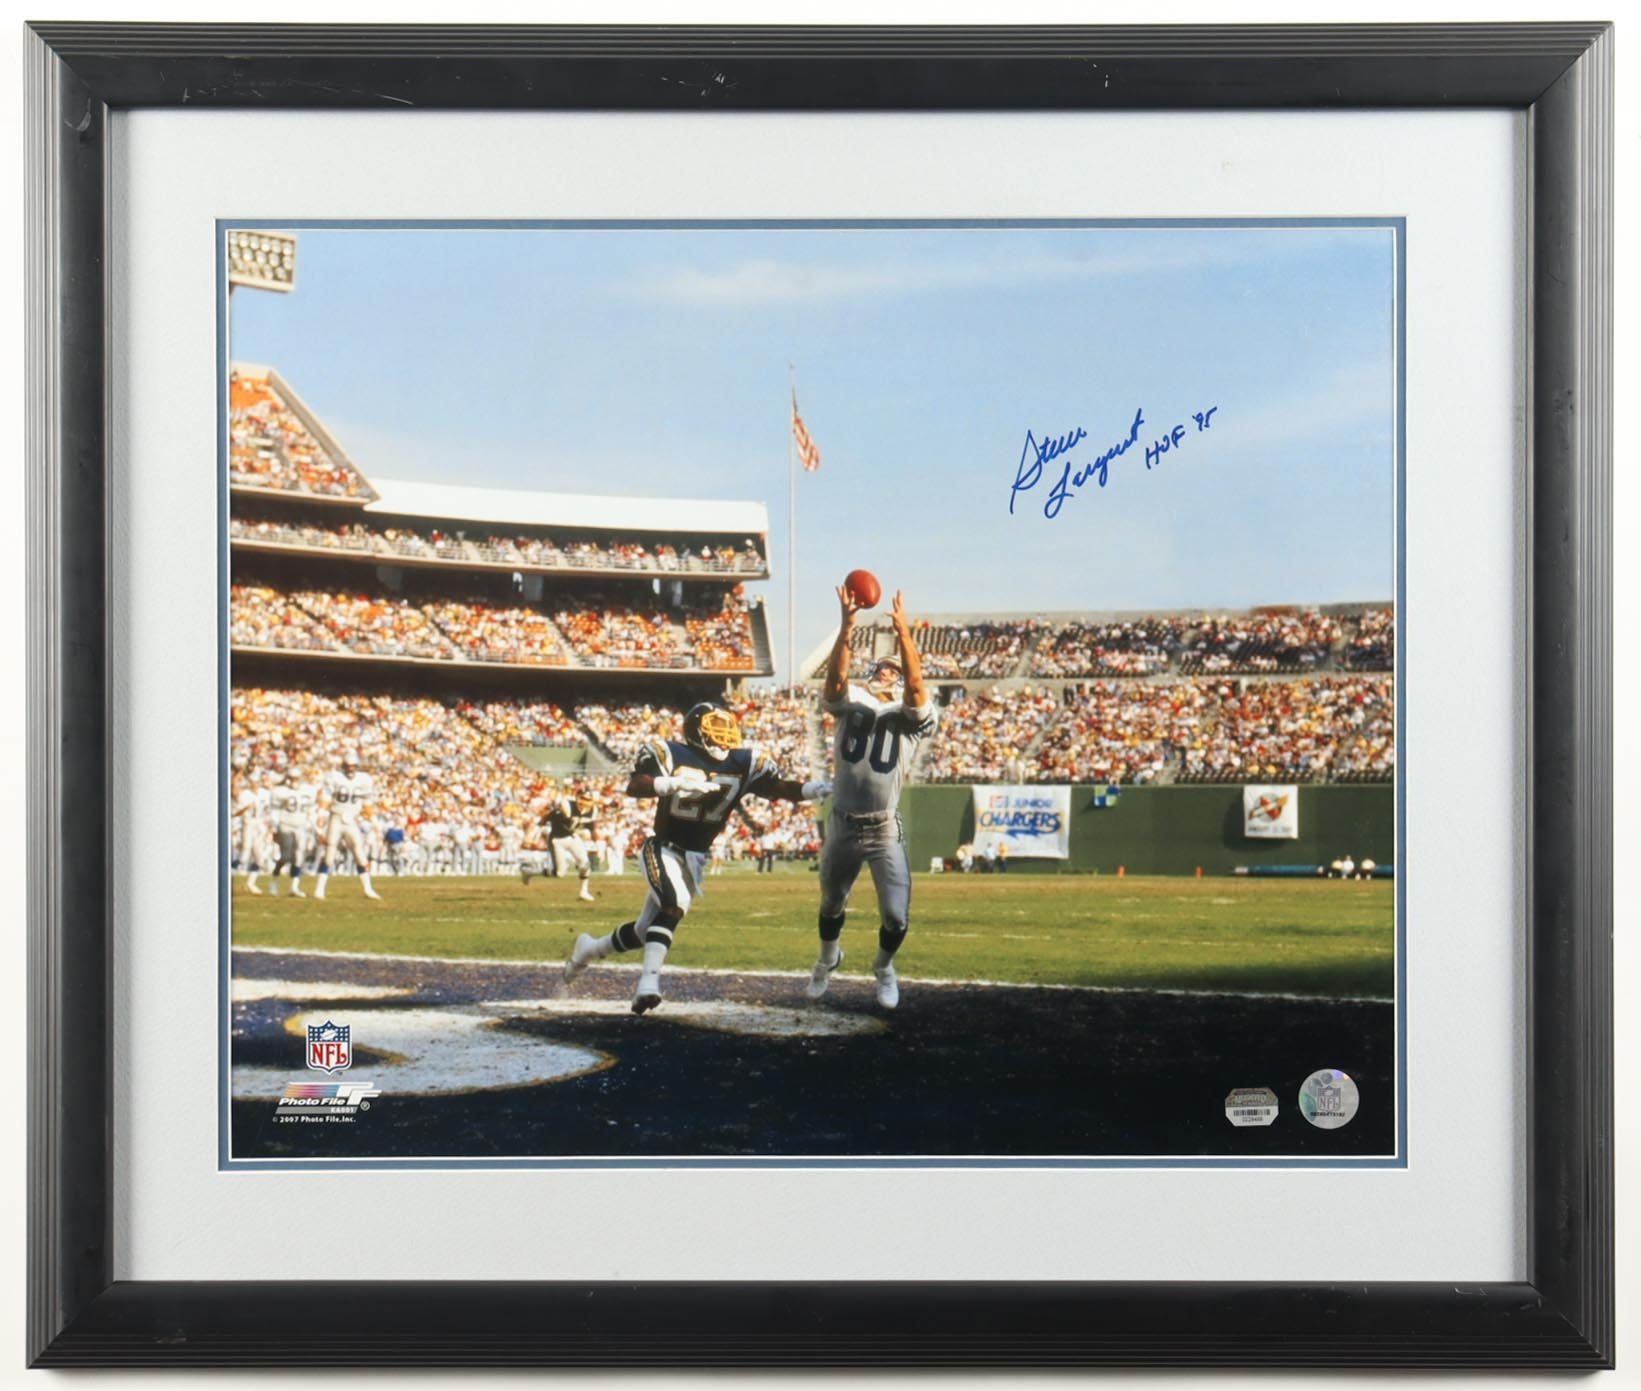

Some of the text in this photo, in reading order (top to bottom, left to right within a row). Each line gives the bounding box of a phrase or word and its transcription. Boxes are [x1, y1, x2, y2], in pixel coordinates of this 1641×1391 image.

[841, 702, 900, 774] 80
[670, 765, 742, 823] 27
[980, 811, 1061, 834] CHARGERS
[311, 1043, 347, 1067] NFL
[278, 1097, 346, 1106] Photo File
[1319, 1097, 1339, 1110] NFL
[300, 1115, 324, 1123] Photo
